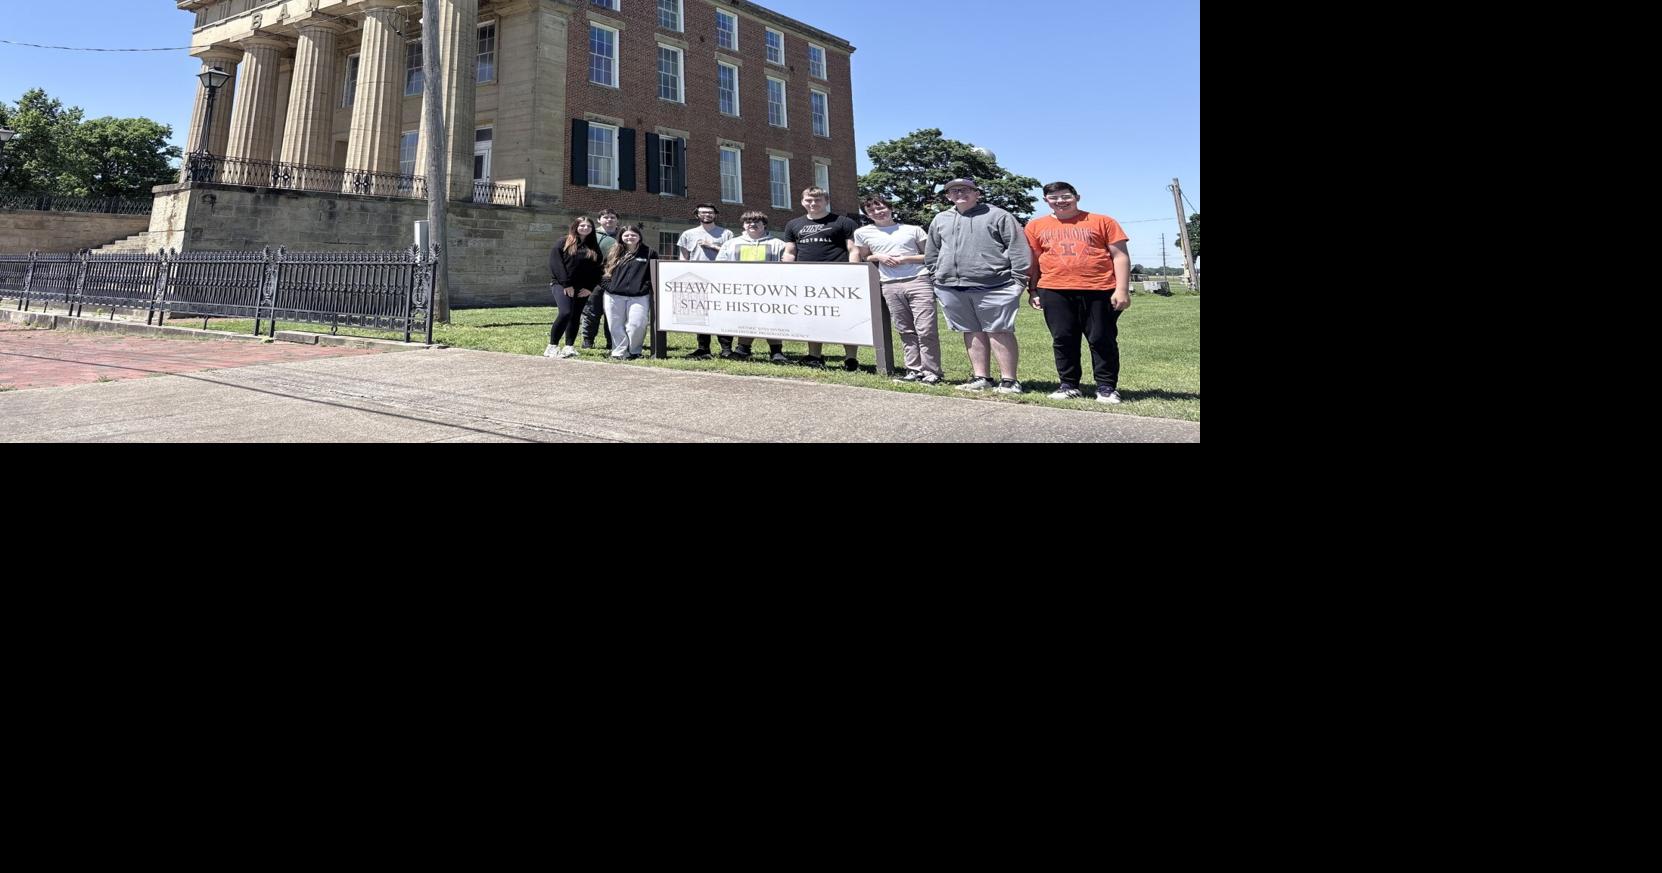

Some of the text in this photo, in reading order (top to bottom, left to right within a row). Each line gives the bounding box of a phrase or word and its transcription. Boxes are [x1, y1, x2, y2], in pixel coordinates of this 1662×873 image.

[664, 281, 863, 300] SHAWNEETOWN BANK
[680, 299, 841, 317] STATE HISTORIC SITE
